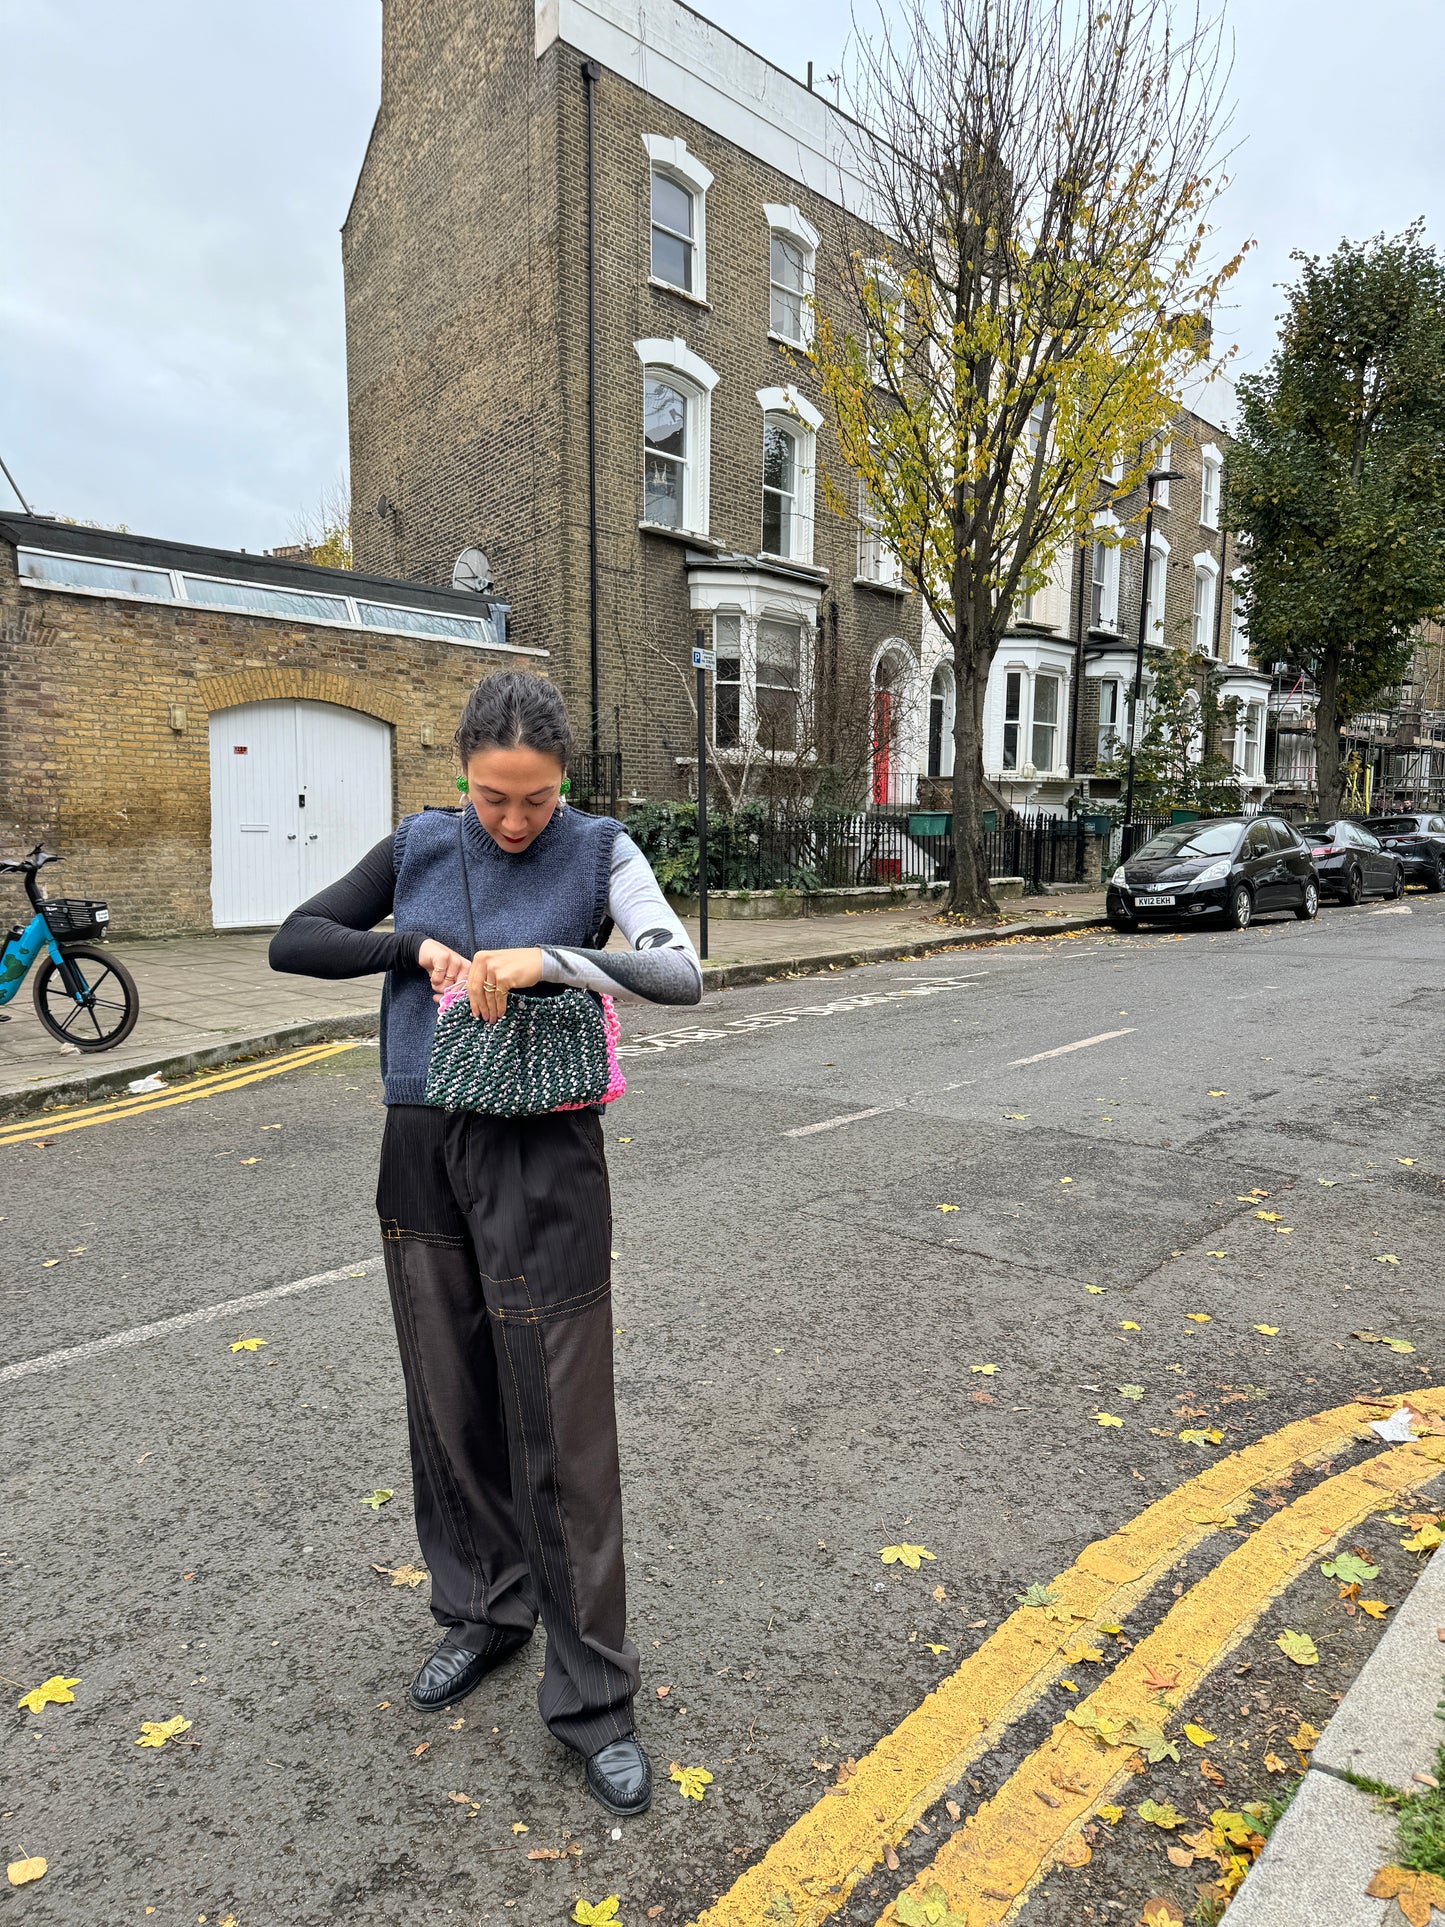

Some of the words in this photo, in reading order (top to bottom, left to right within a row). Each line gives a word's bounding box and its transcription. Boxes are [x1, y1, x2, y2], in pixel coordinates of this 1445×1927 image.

[1138, 897, 1155, 905] KV12
[1155, 896, 1171, 905] EKH
[614, 1016, 799, 1060] ISABLED
